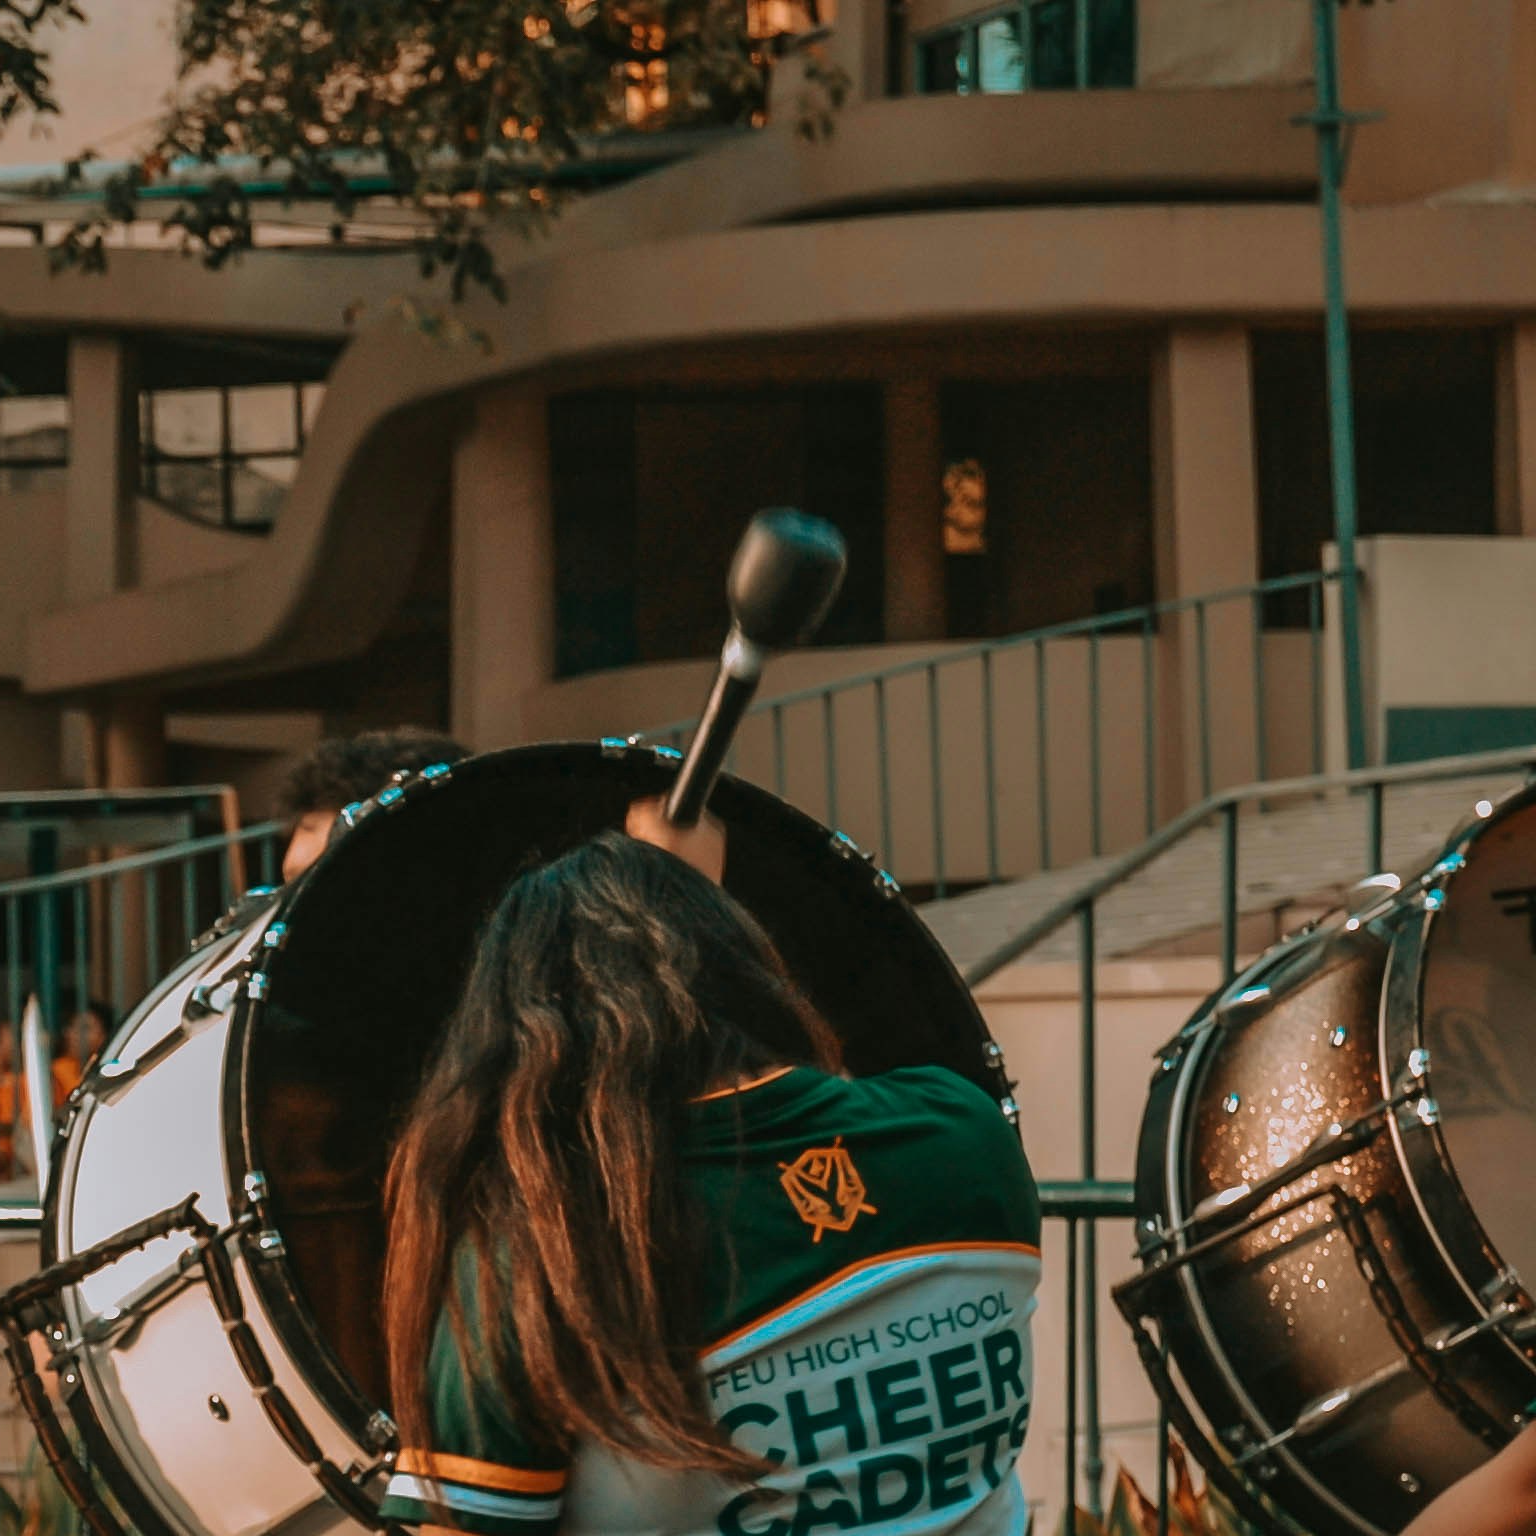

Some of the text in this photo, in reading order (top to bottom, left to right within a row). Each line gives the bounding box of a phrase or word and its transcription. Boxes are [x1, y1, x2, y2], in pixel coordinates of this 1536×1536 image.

[709, 1291, 1013, 1400] FEU HIGH SCHOOL
[716, 1329, 1024, 1468] CHEER
